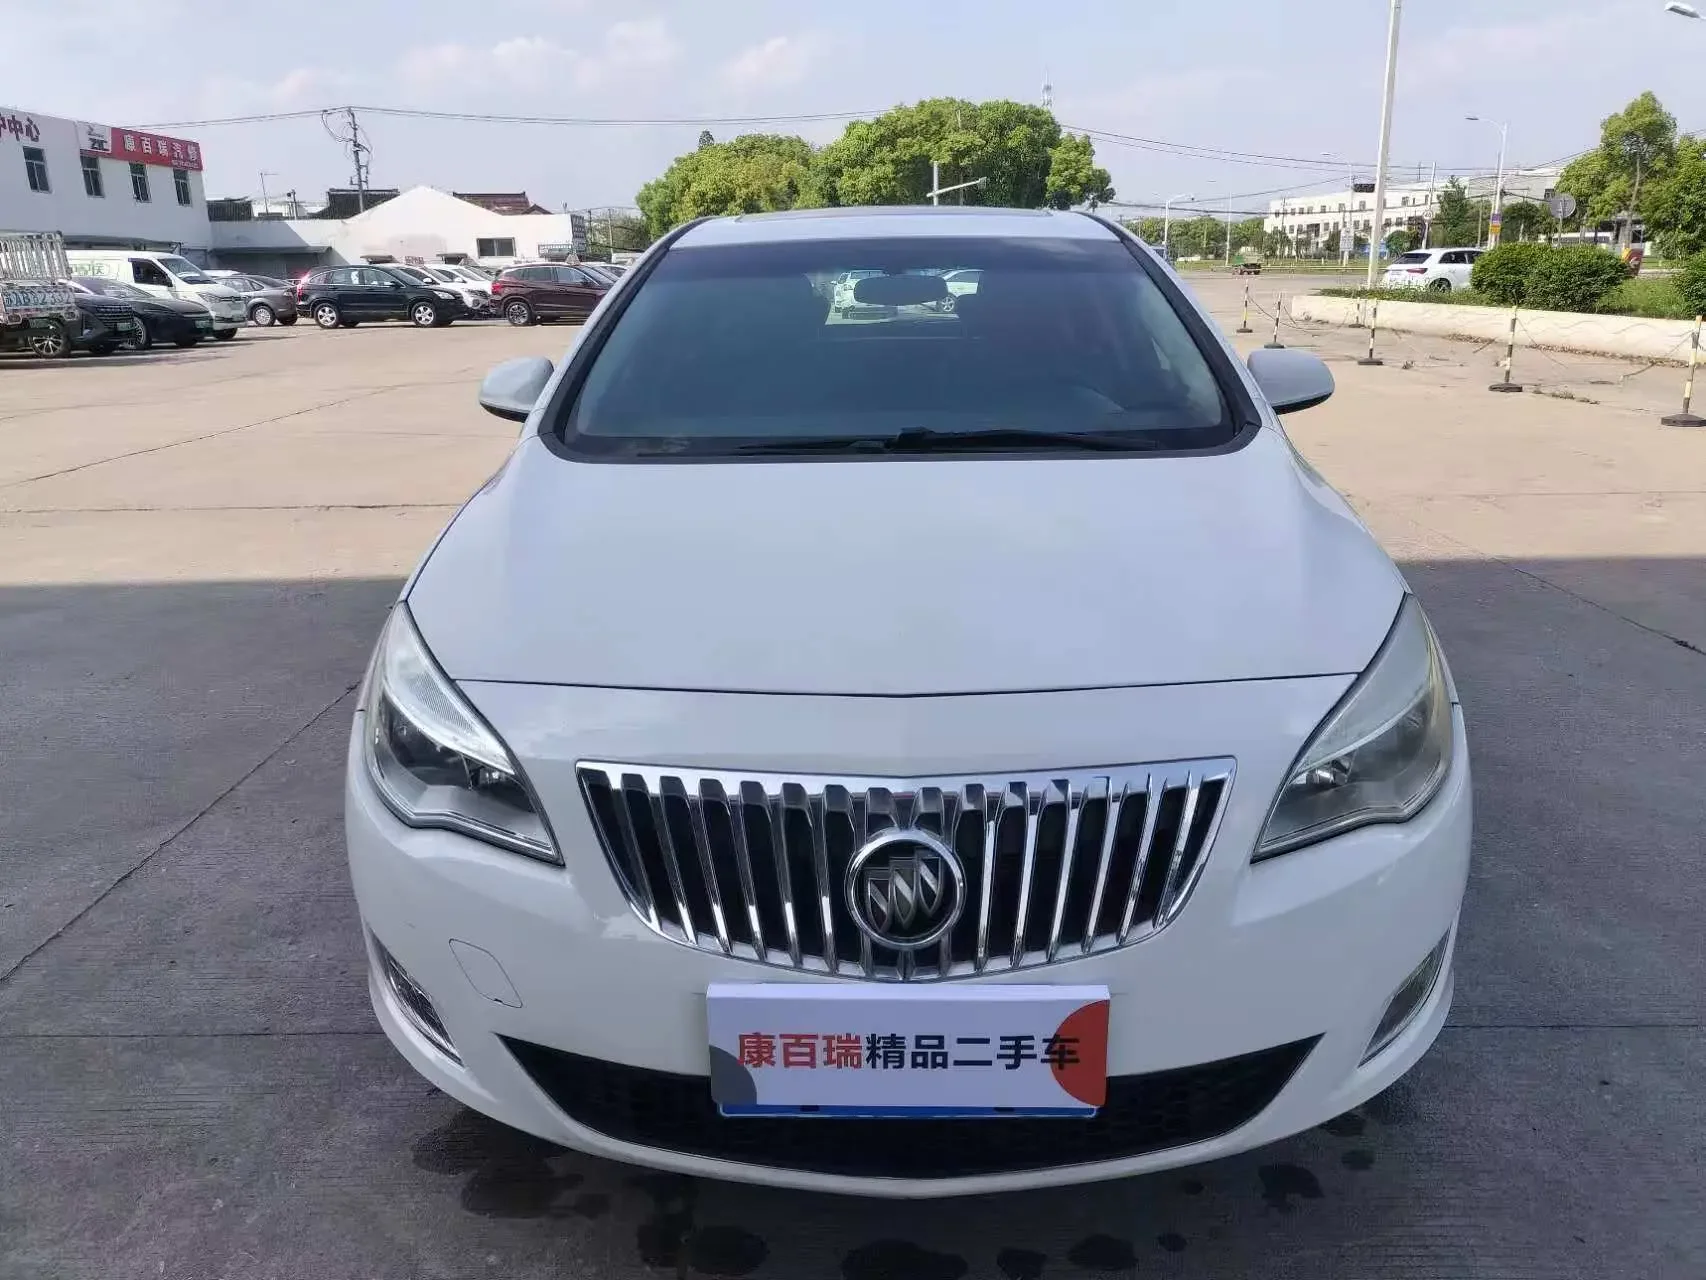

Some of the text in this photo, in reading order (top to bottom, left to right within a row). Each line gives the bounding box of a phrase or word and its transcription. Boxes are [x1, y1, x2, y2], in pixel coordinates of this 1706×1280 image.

[737, 1032, 1081, 1071] 康百瑞精品二手车
